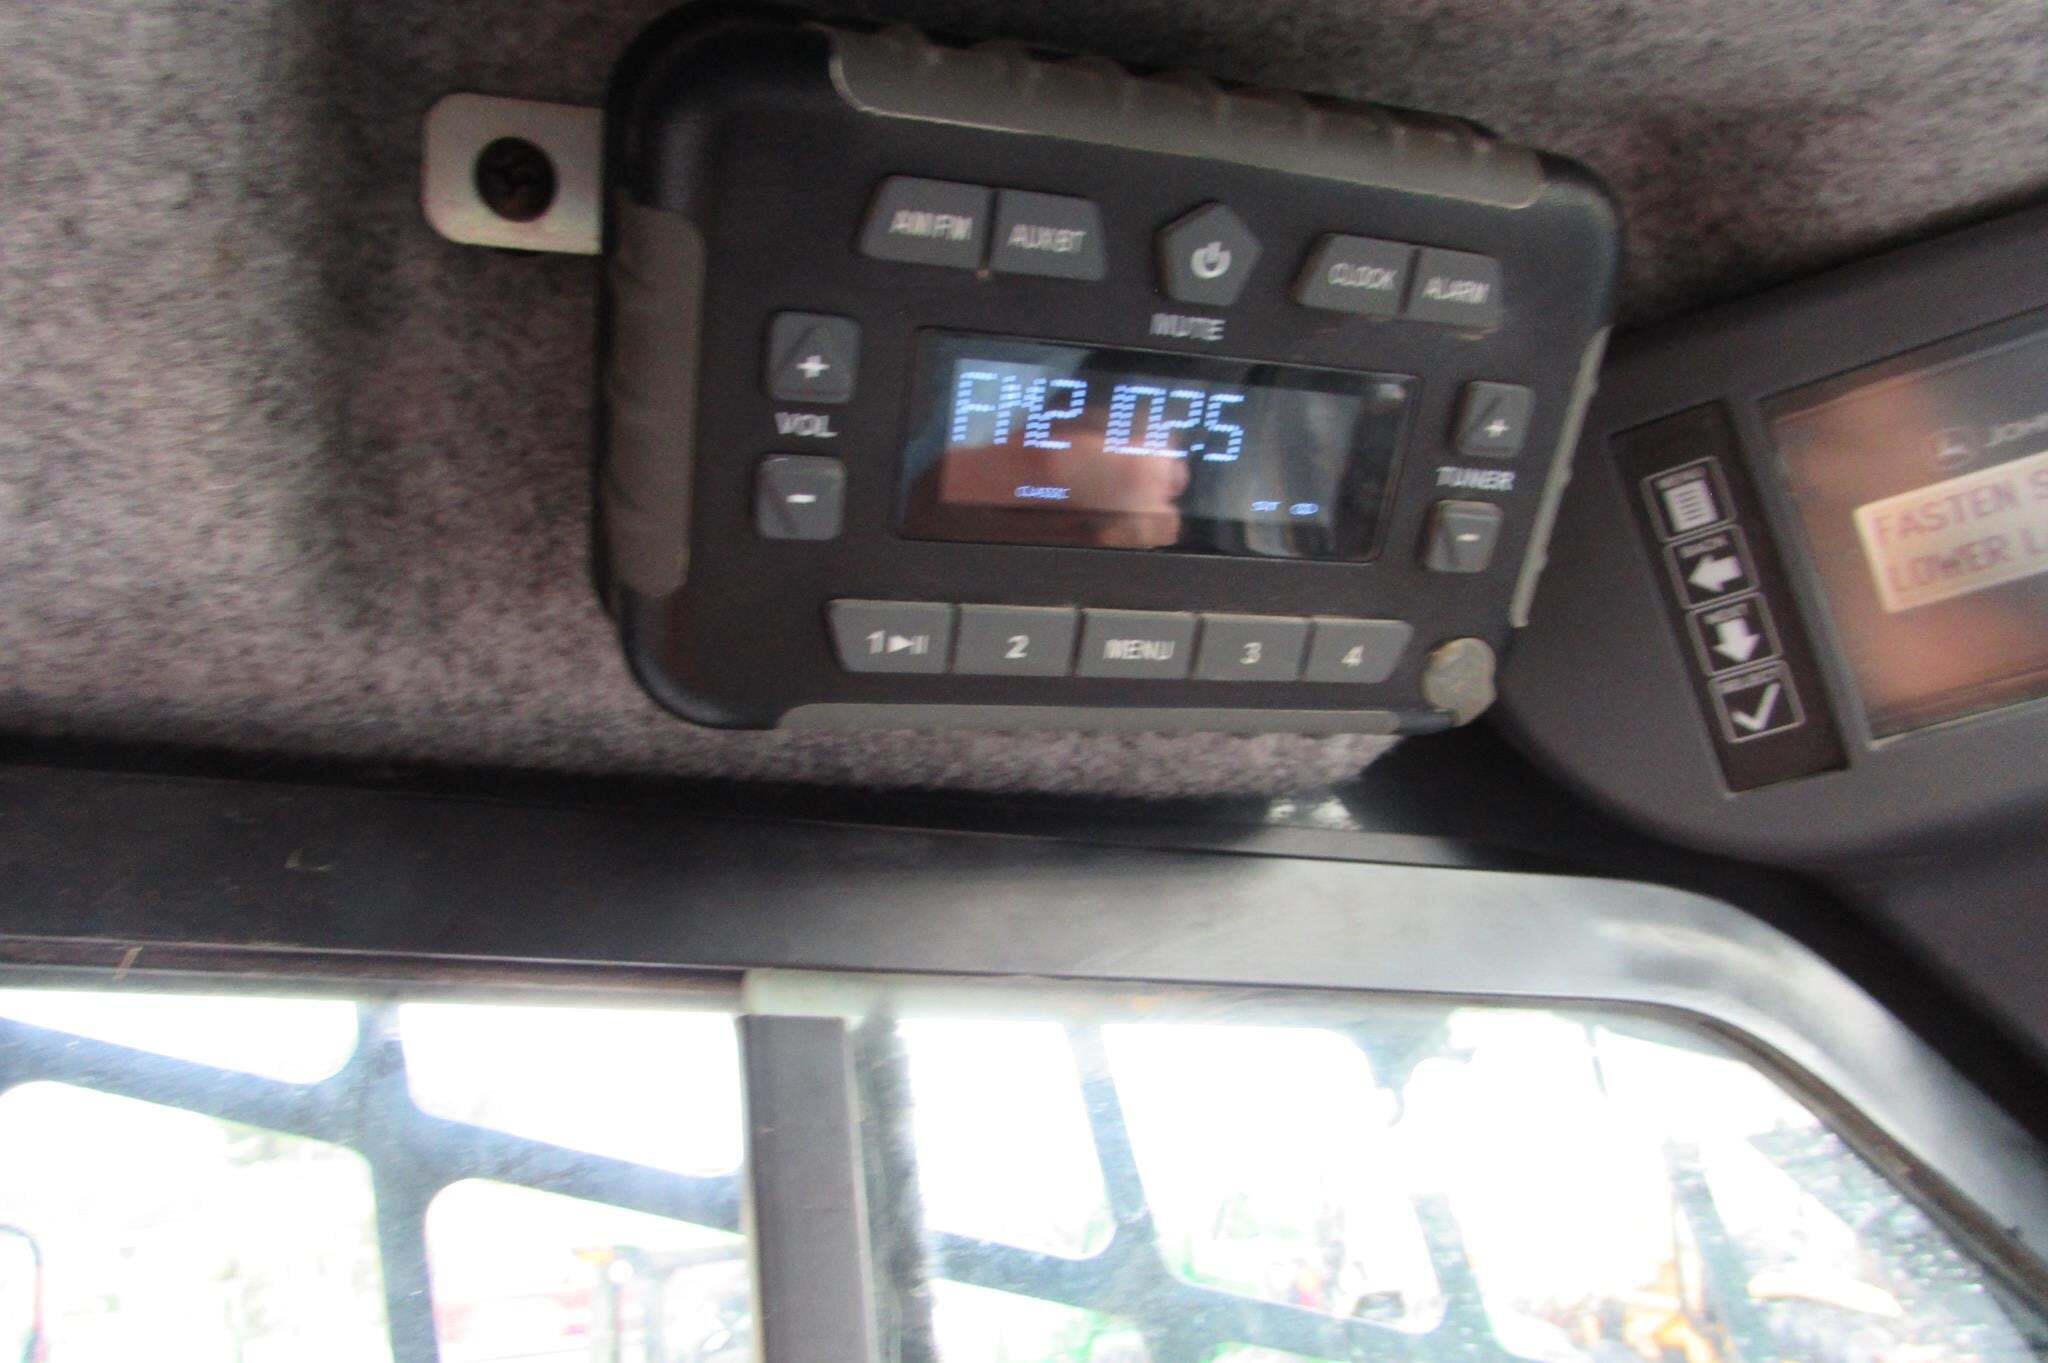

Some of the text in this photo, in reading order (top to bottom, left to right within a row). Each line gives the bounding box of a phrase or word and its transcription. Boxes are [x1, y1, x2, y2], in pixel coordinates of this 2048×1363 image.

[1328, 262, 1397, 291] CLOCK
[1423, 276, 1491, 305] ALARM
[1149, 312, 1226, 342] MUTE
[774, 411, 838, 438] VOL
[1436, 466, 1515, 491] TUNER
[1869, 482, 2021, 546] FASTEN
[1004, 635, 1029, 659] 2
[1103, 638, 1175, 661] MENU
[1240, 642, 1262, 665] 3
[1341, 645, 1364, 667] 4
